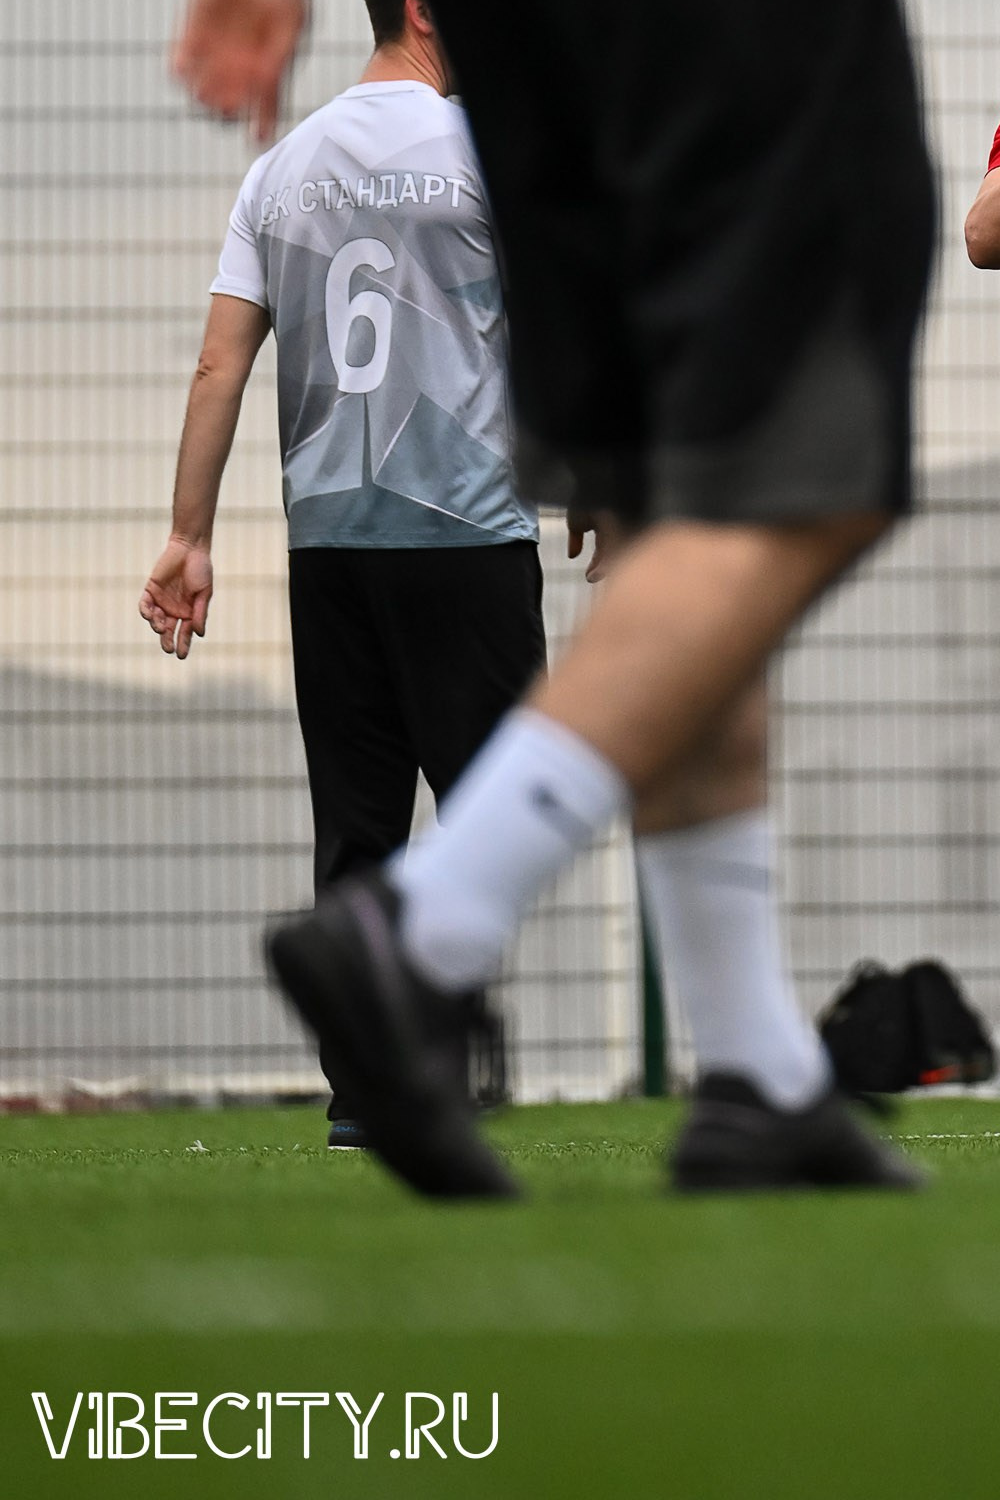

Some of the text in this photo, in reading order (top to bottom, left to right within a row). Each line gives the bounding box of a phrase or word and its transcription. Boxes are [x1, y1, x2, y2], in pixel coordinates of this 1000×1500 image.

[260, 173, 468, 226] СК СТАНДАРТ
[326, 237, 395, 394] 6
